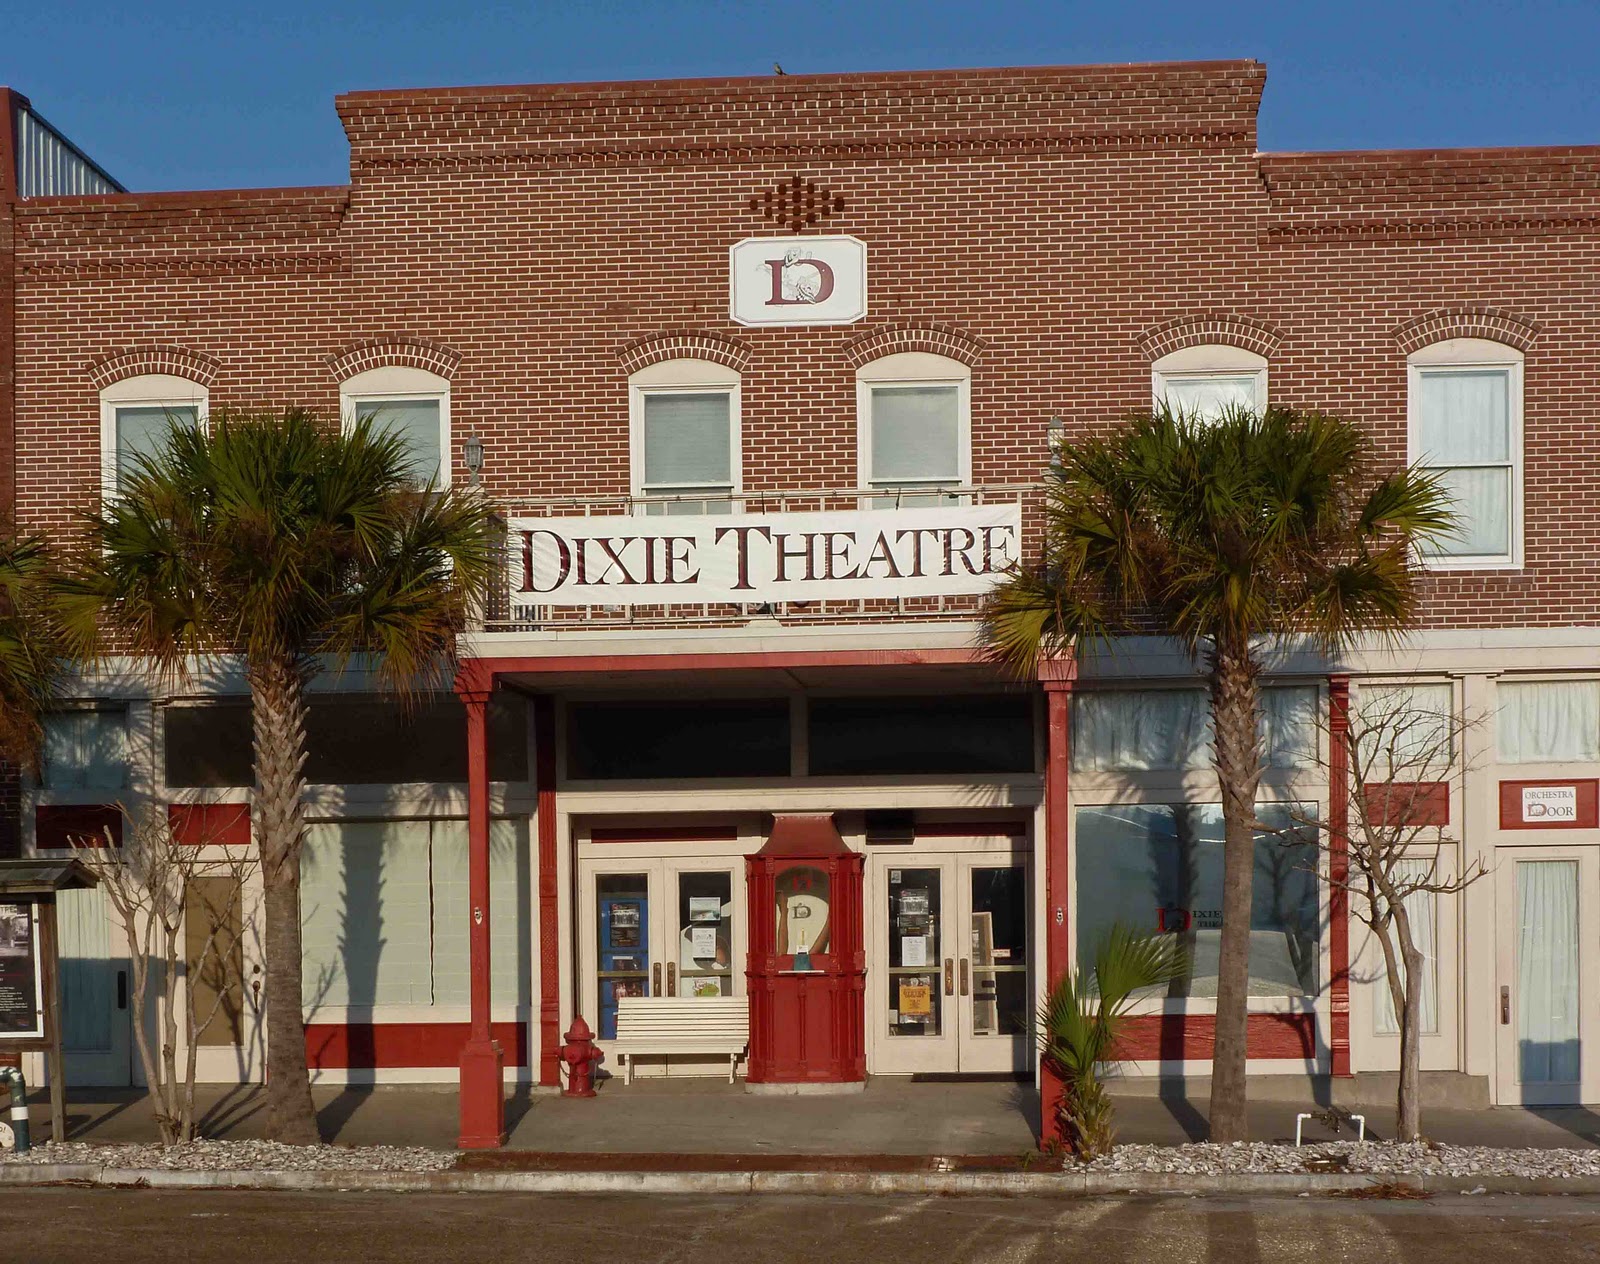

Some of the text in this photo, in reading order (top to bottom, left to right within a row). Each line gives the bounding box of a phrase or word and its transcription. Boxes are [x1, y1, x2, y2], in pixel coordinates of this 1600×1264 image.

[516, 523, 1018, 593] DIXIE THEATRE
[1524, 790, 1574, 799] ORCHESTRA
[1527, 803, 1574, 817] DOOR
